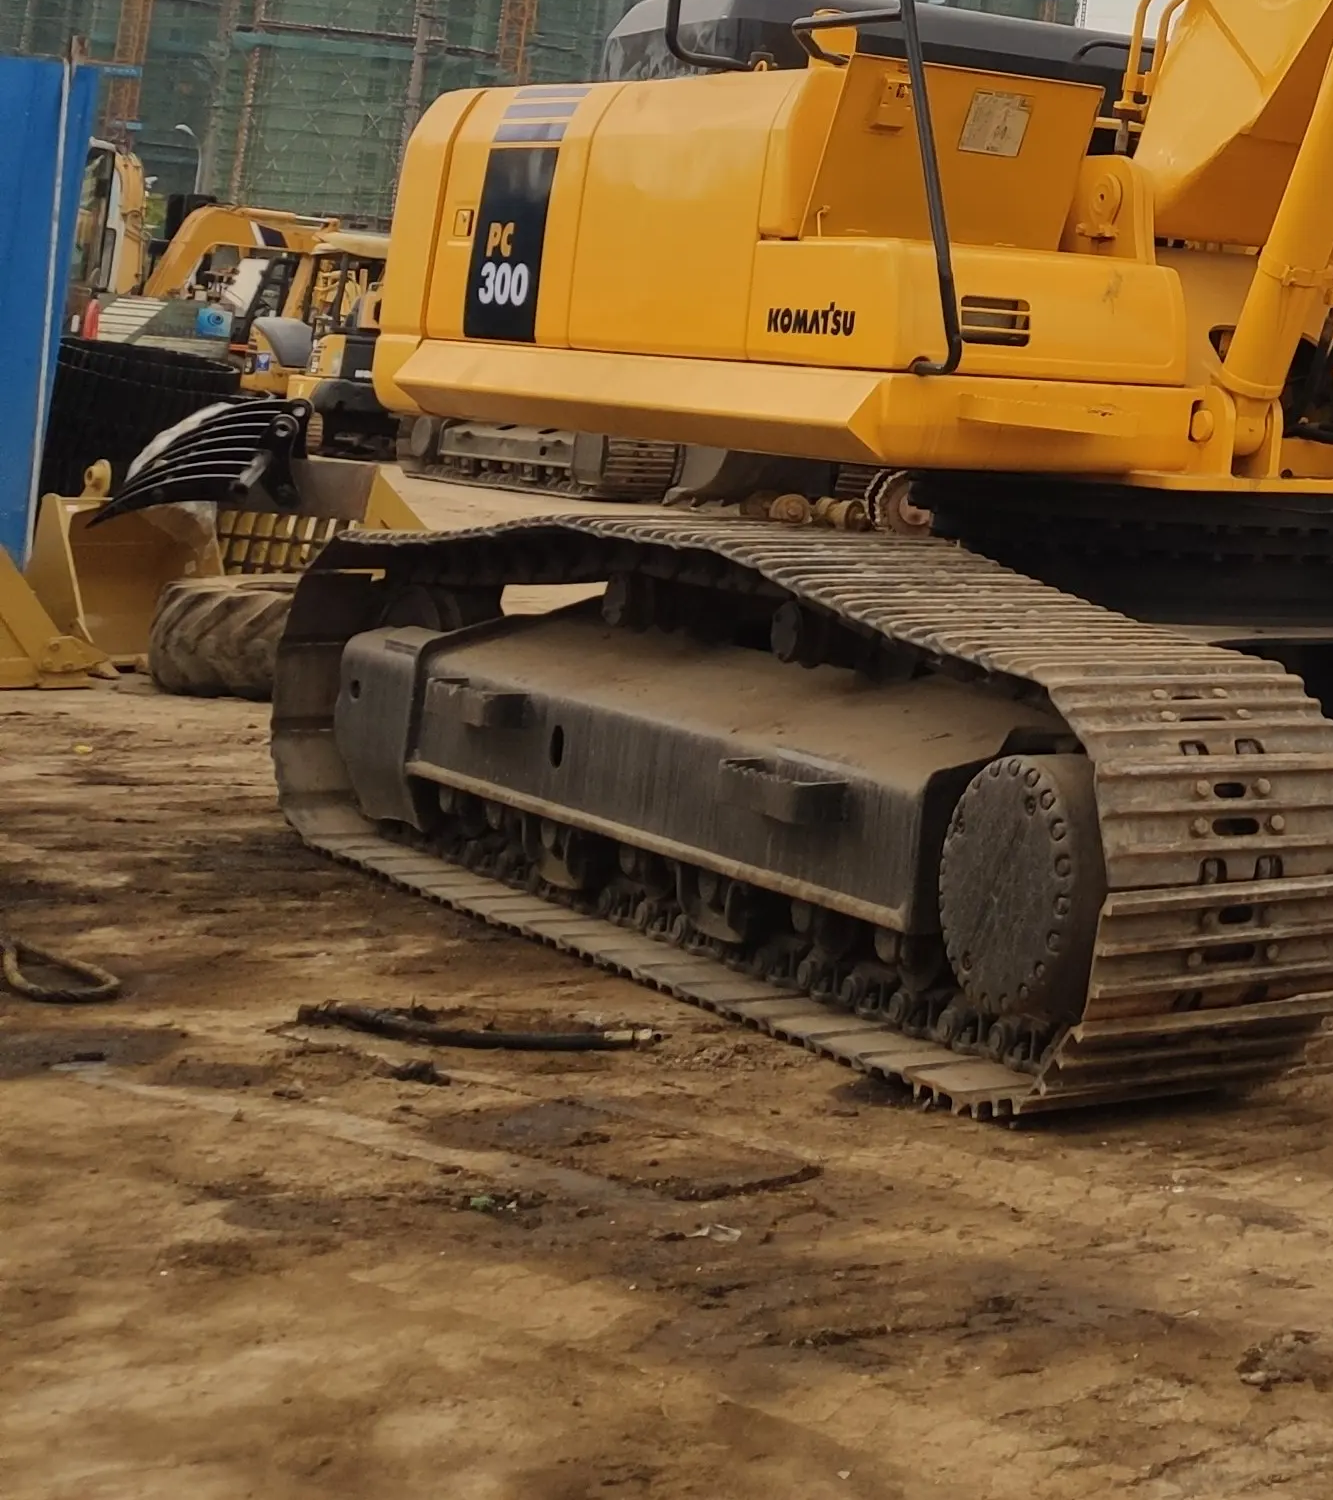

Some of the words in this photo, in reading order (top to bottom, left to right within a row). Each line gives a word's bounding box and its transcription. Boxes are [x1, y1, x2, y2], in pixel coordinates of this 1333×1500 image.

[486, 222, 515, 257] PC
[478, 261, 529, 306] 300
[766, 301, 856, 337] KOMATSU
